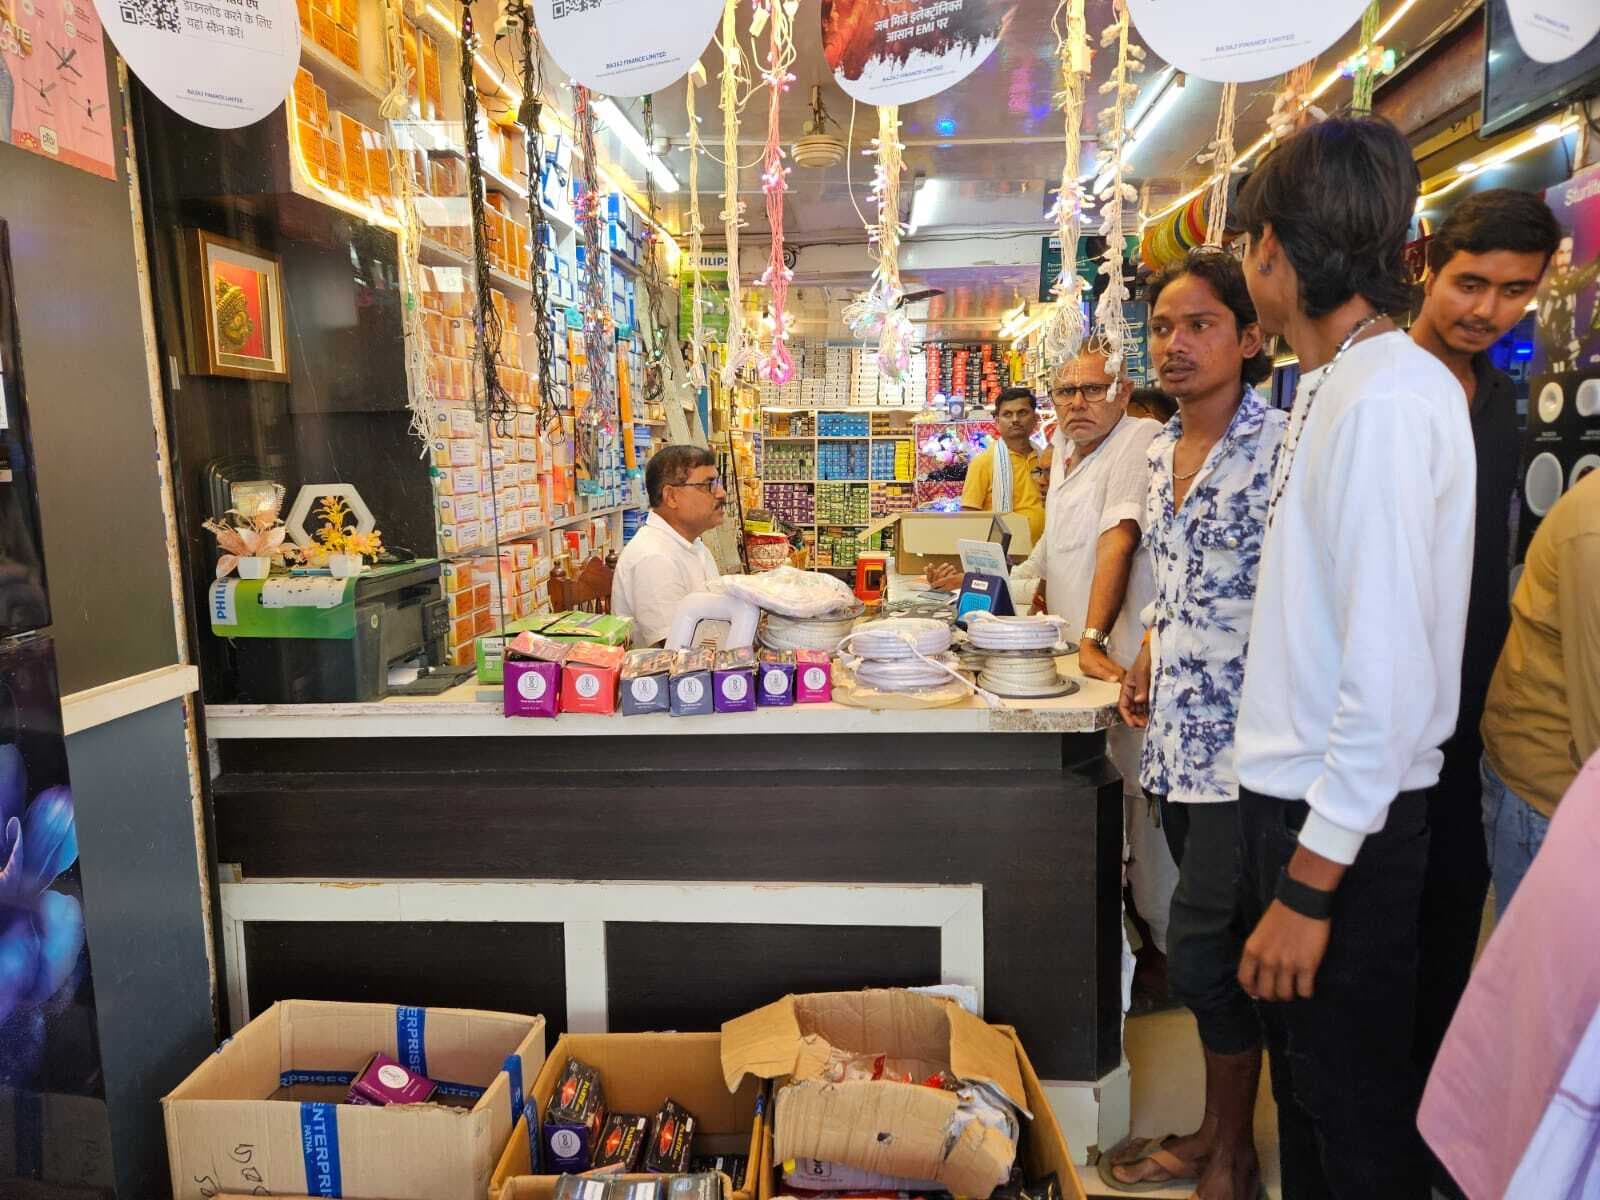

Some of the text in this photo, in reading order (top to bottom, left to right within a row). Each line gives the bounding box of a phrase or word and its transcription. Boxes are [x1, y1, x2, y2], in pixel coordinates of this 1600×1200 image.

[0, 18, 32, 44] ATE
[874, 19, 889, 31] जब
[886, 27, 913, 42] आसान
[916, 22, 935, 35] EMI
[624, 56, 645, 66] FINANCE
[645, 51, 667, 61] LIMITED
[304, 1124, 313, 1154] PATNA
[312, 1102, 331, 1198] ENTERPRI
